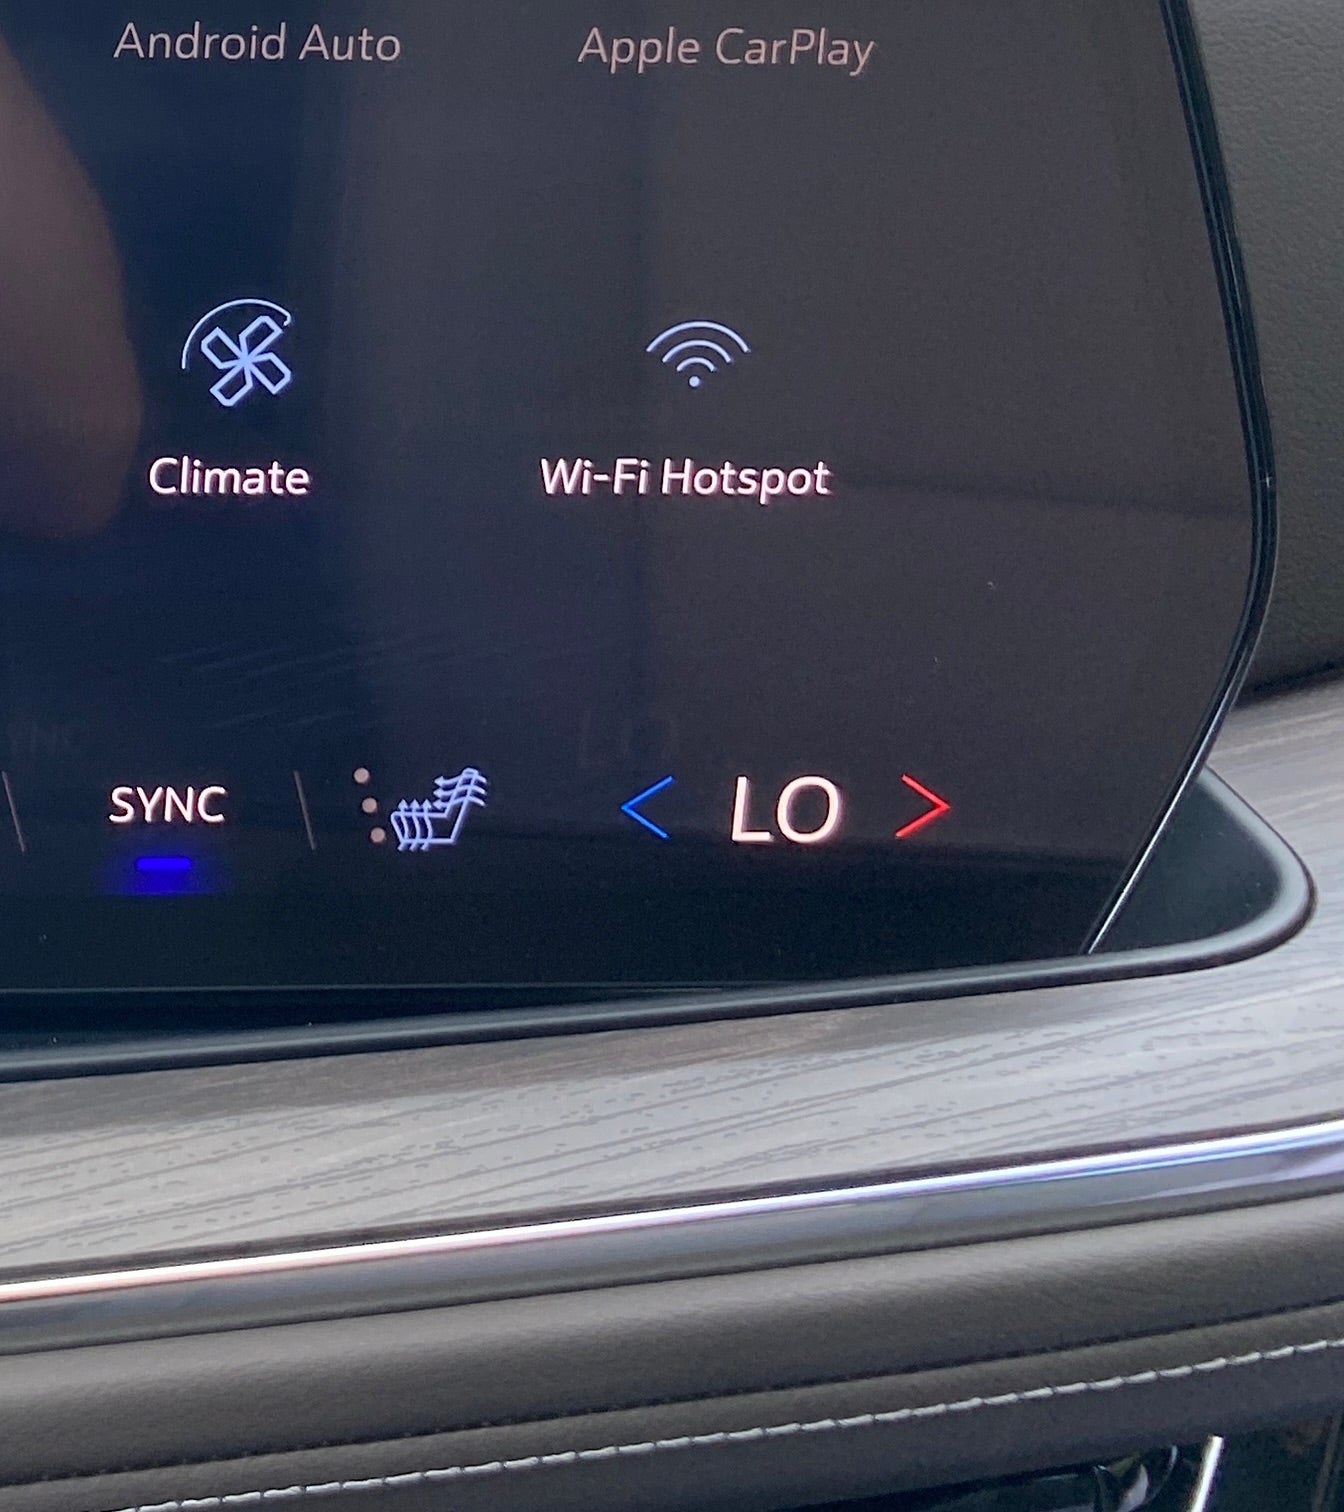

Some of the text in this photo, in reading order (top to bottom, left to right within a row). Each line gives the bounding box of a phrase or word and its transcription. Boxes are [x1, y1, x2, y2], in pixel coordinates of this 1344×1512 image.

[113, 20, 401, 61] Android Auto
[577, 26, 875, 77] Apple CarPlay
[149, 455, 310, 495] Climate
[541, 458, 831, 504] Wi-Fi Hotspot
[108, 785, 226, 823] SYNC
[731, 776, 841, 843] LO
